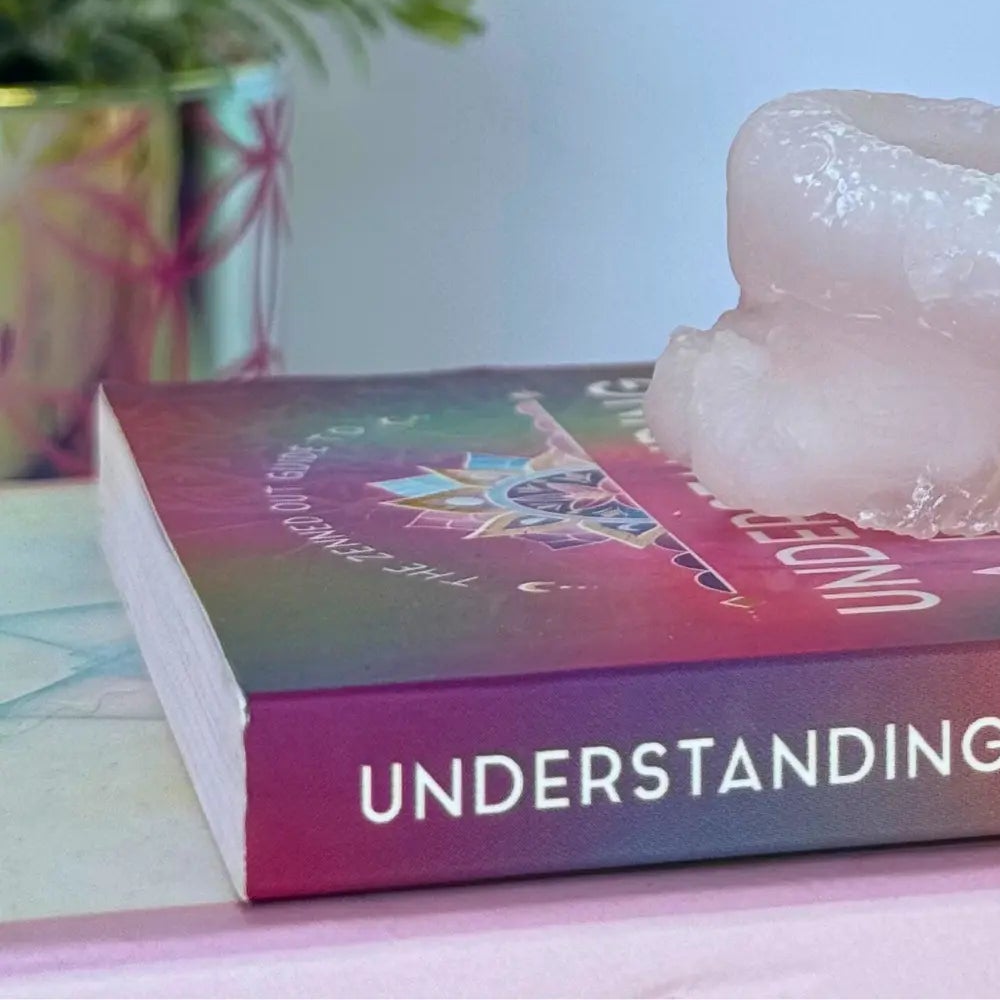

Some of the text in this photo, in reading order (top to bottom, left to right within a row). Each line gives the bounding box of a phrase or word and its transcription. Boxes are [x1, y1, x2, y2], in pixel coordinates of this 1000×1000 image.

[265, 484, 312, 511] OUT
[283, 516, 394, 562] ZENNED
[382, 562, 478, 587] THE
